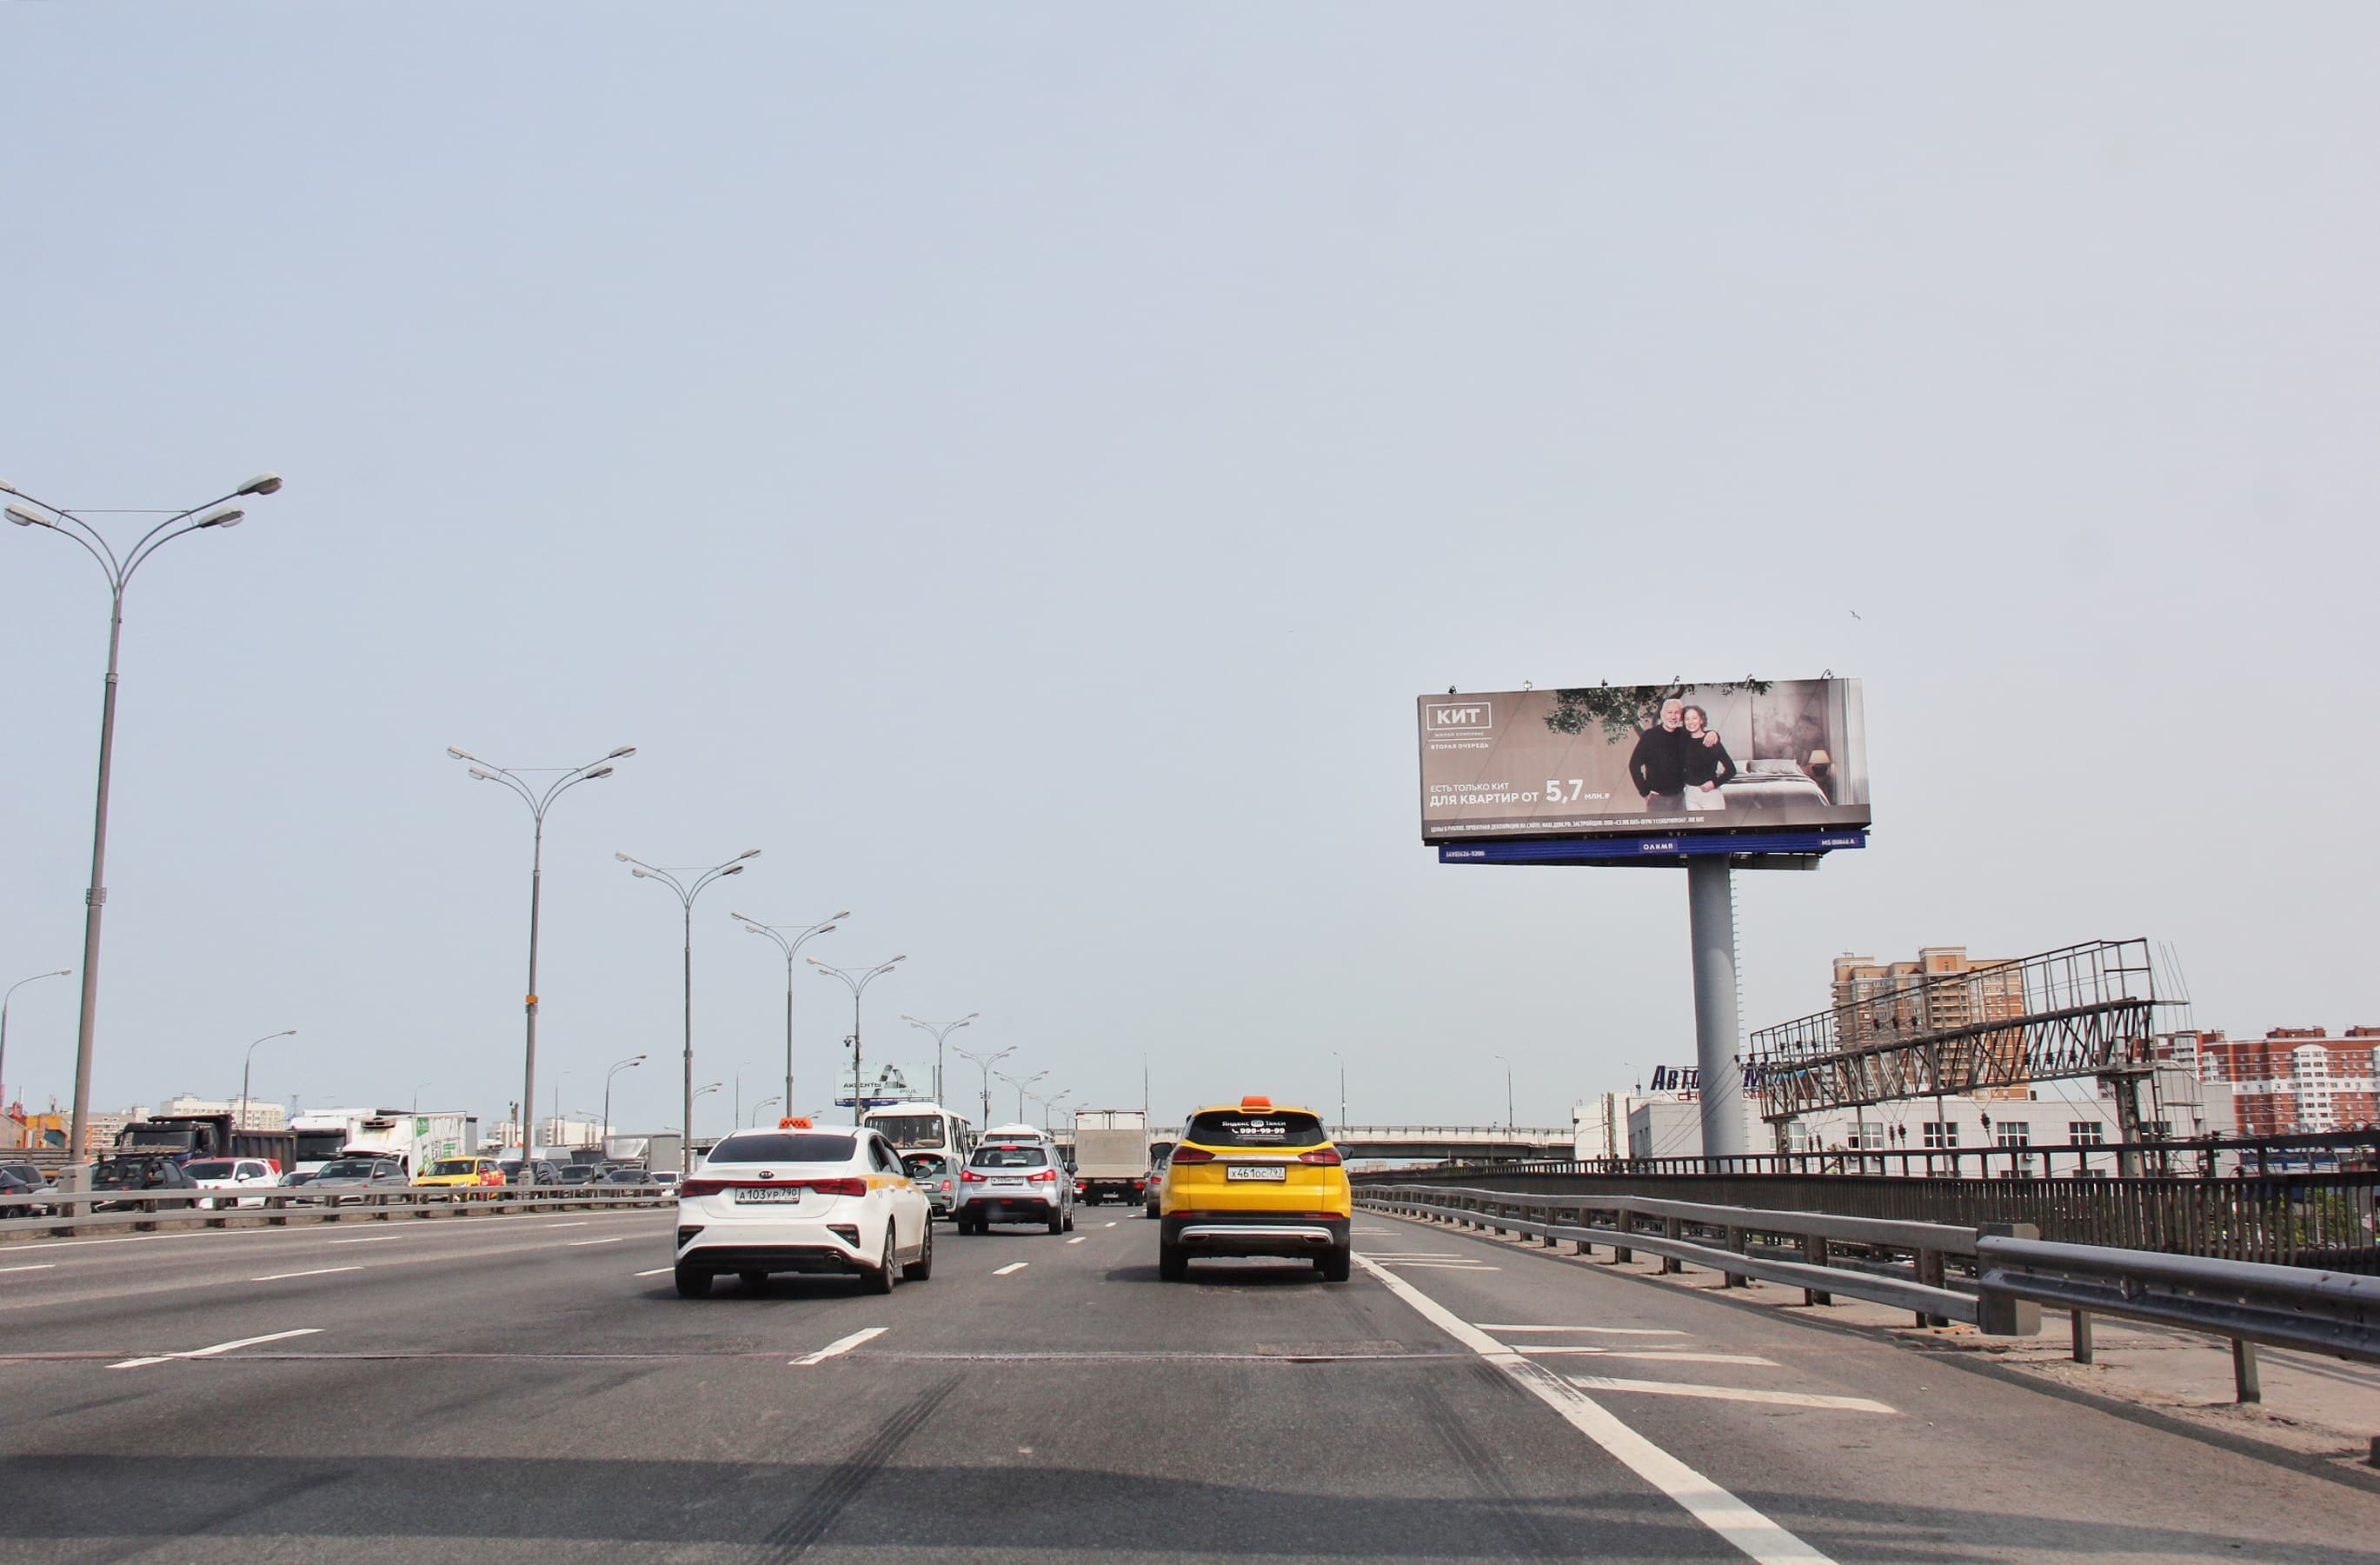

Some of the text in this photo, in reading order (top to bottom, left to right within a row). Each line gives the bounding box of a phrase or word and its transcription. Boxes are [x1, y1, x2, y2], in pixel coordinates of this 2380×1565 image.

[1437, 709, 1480, 724] КИТ
[1430, 782, 1510, 793] ЕСТЬ ТОЛЬКО КИТ
[1430, 795, 1458, 808] ДЛЯ
[1460, 792, 1519, 805] КВАРТИР
[1521, 792, 1539, 802] ОТ
[1546, 779, 1584, 804] 5,7
